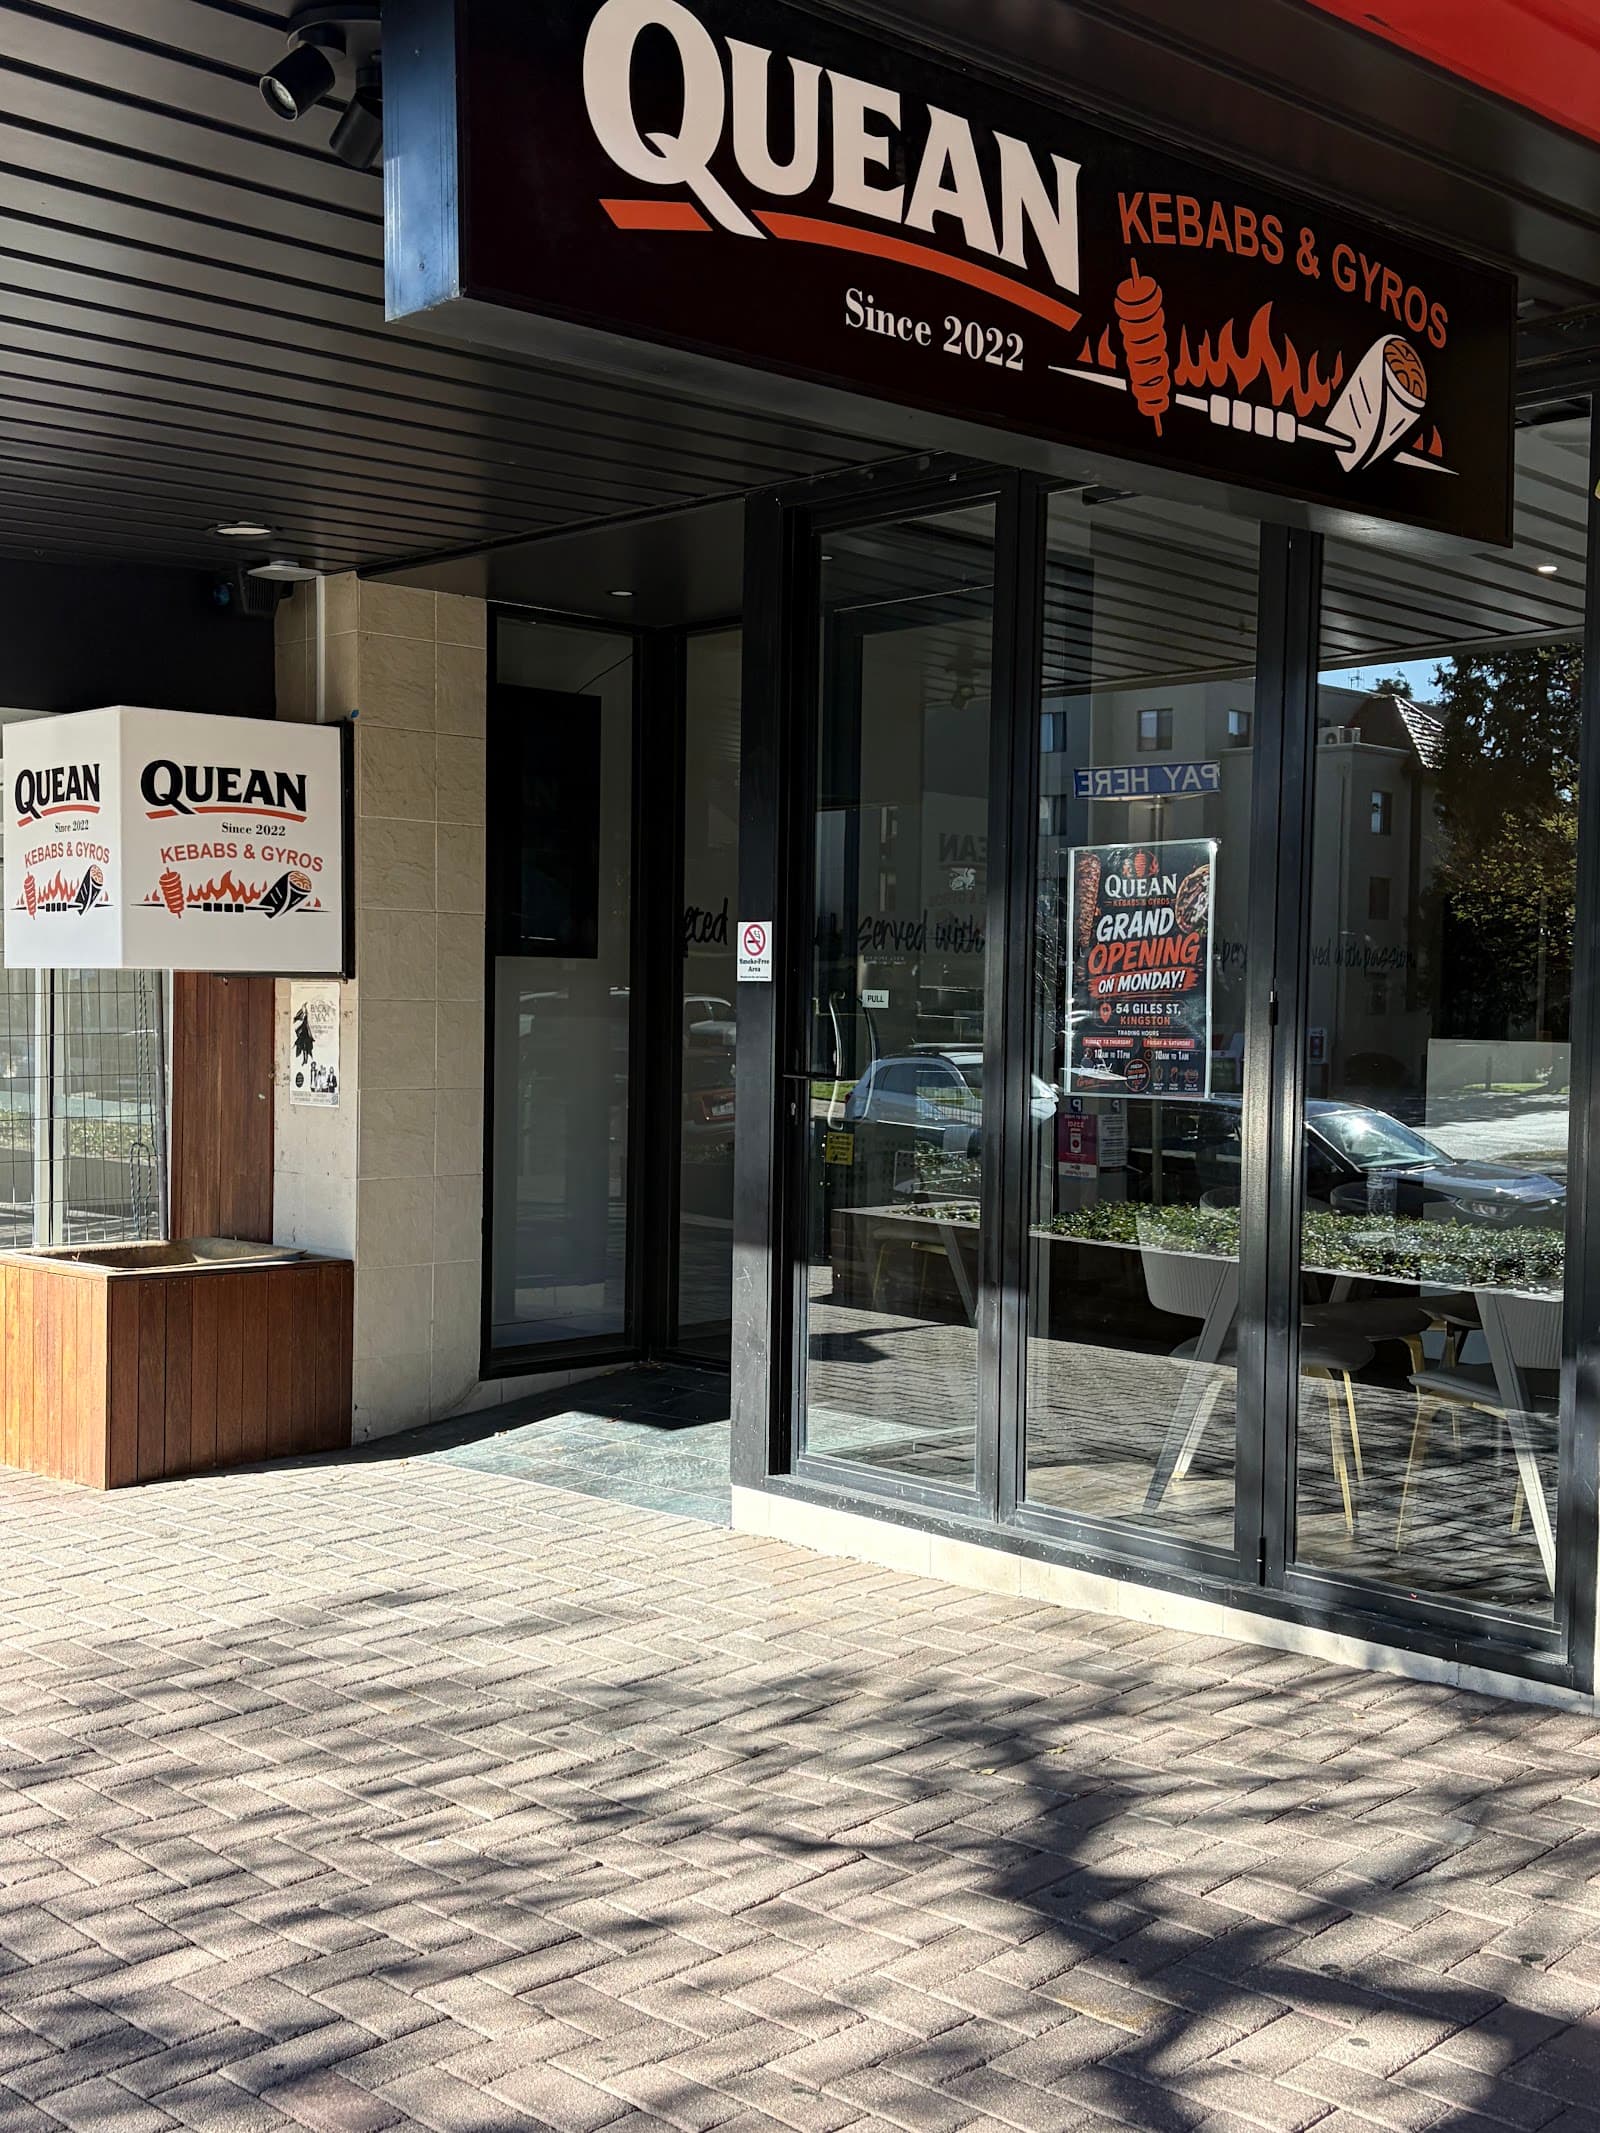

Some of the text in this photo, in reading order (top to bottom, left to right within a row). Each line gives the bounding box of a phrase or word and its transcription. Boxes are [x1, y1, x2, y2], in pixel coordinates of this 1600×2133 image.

[583, 0, 1081, 295] QUEAN
[1117, 191, 1448, 349] KEBABS & GYROS
[845, 287, 1024, 370] Since 2022
[14, 763, 100, 819] QUEAN
[141, 760, 307, 815] QUEAN
[54, 819, 89, 833] Since 2022
[221, 822, 286, 837] Since 2022
[24, 842, 110, 868] KEBABS & GYROS
[161, 843, 323, 872] KEBABS & GYROS
[1105, 873, 1177, 898] QUEAN
[1096, 908, 1175, 942] GRAND
[1087, 932, 1200, 975] OPENING
[1098, 970, 1184, 994] ON MONDAY!
[867, 994, 885, 1003] PULL
[1116, 1003, 1181, 1016] 54 GILES ST,
[1120, 1015, 1170, 1025] KINGSTON
